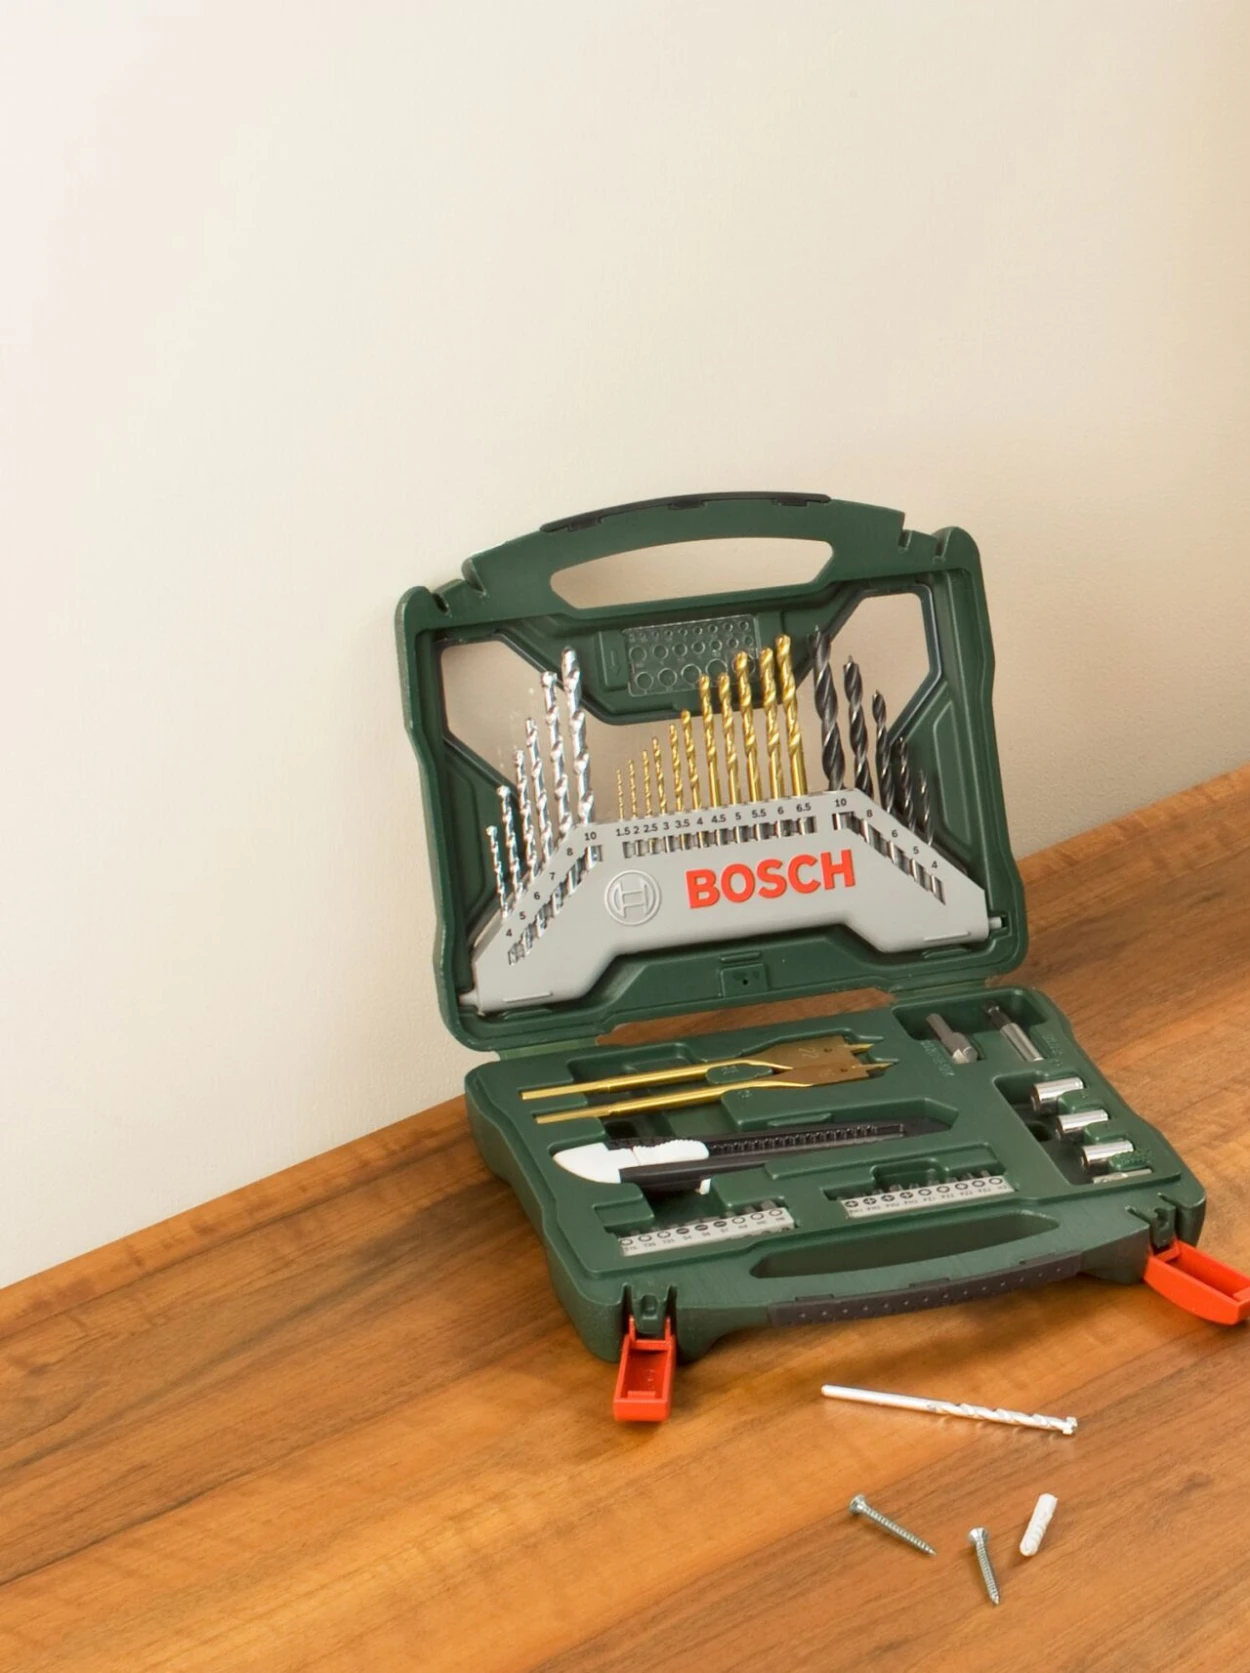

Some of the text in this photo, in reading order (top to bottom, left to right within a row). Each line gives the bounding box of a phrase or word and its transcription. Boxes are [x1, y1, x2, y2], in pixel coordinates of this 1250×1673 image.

[615, 802, 812, 837] 1.5 2 2.5 3 3.5 4 4.5 5 5.5 6 6.5
[834, 798, 938, 869] 10 8 6 5 4
[505, 831, 598, 937] 4 5 6 7 8 10
[686, 849, 855, 909] BOSCH
